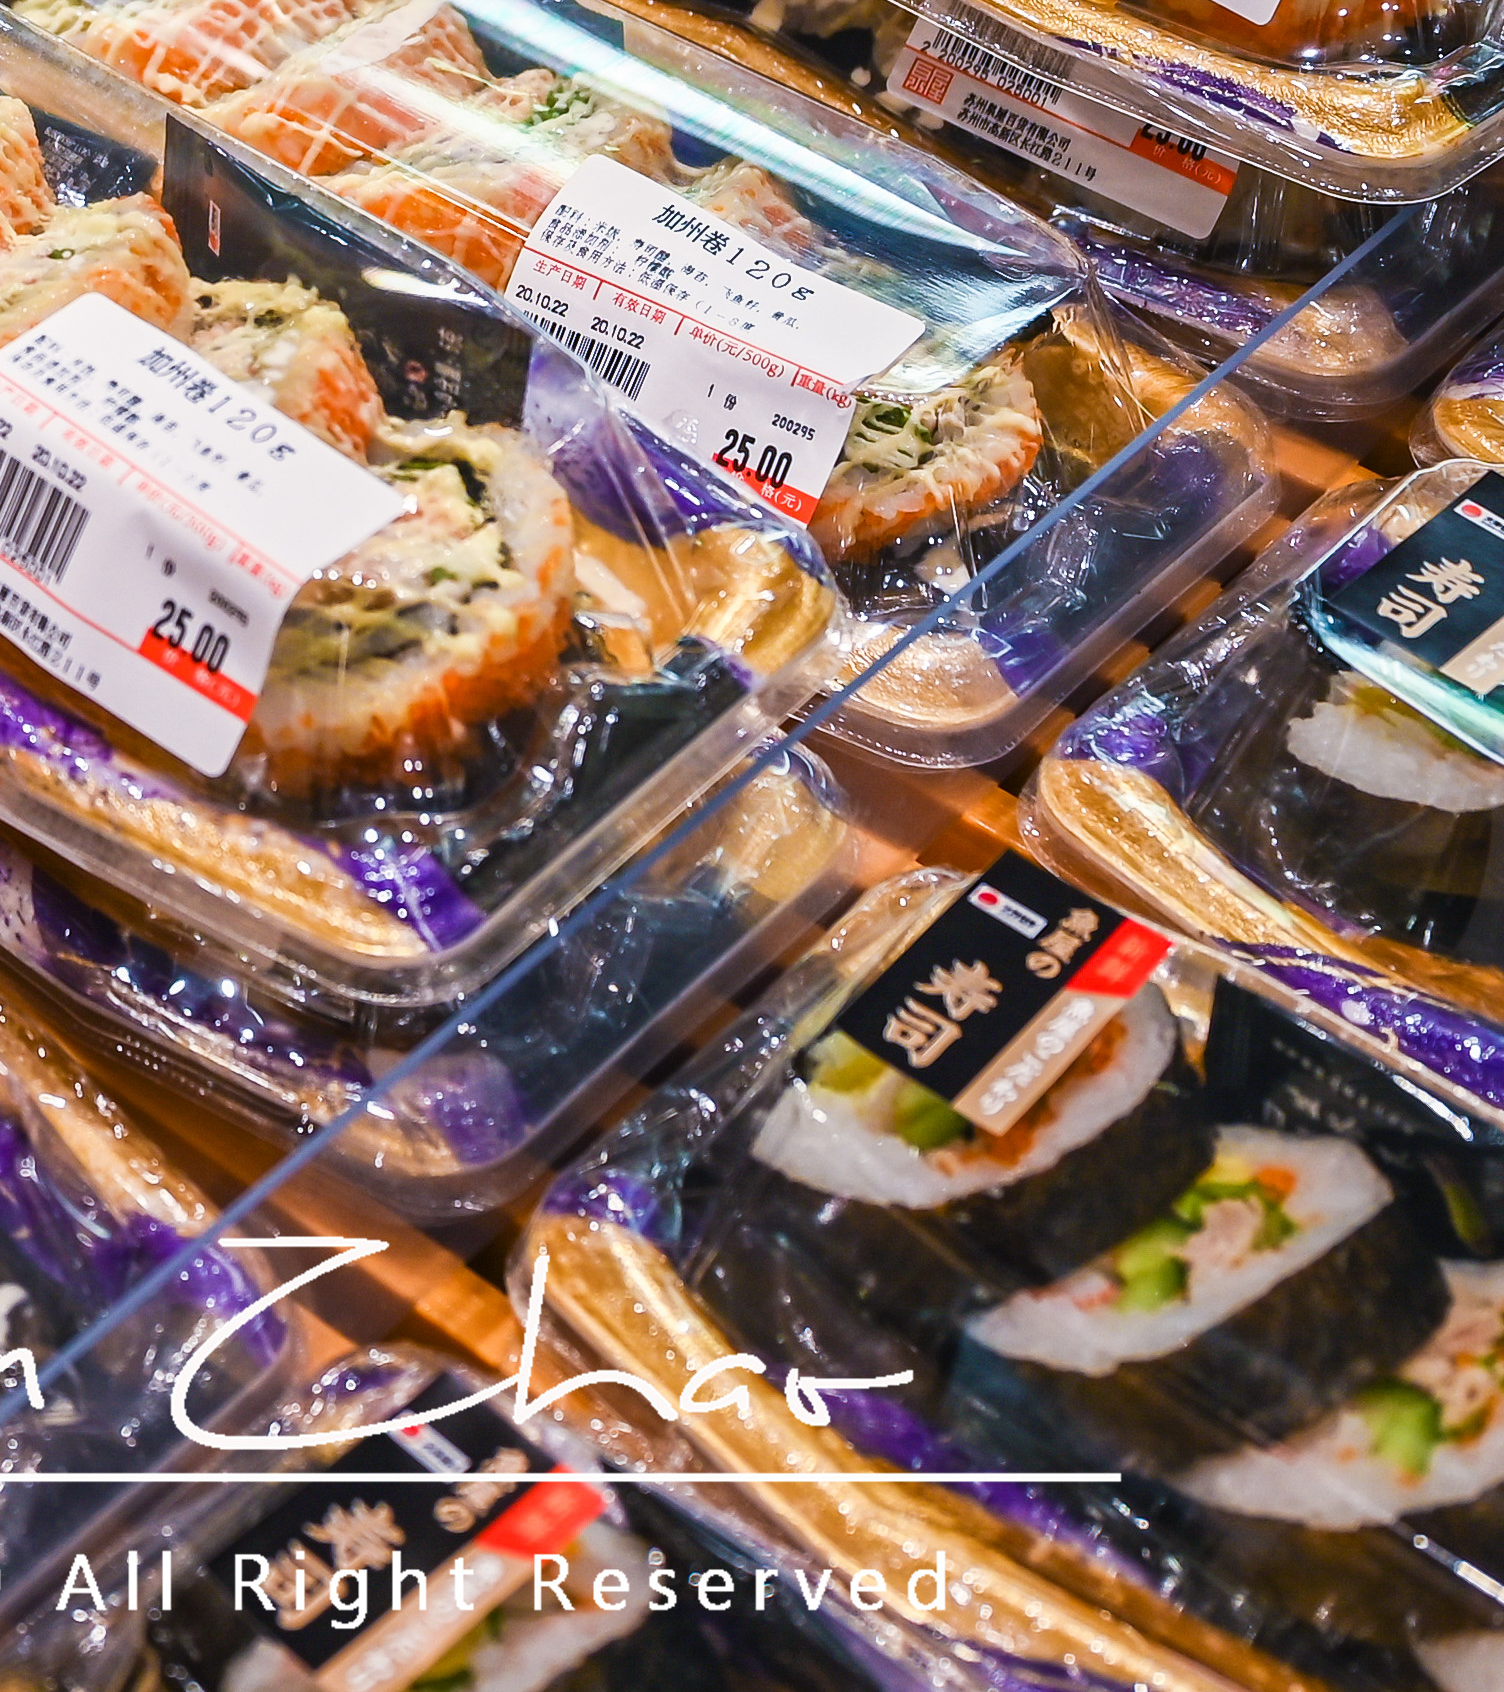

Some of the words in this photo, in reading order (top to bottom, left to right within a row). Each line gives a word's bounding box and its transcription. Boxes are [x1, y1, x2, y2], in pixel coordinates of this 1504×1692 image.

[920, 41, 931, 55] 2
[937, 50, 990, 83] 200295
[995, 76, 1049, 108] 025001
[956, 108, 1098, 182] 苏州市高新区长江路211号
[1181, 156, 1223, 185] 格(元)
[651, 204, 815, 301] 加州卷120g
[515, 284, 569, 317] 20.10.22
[590, 316, 645, 350] 20.10.22
[533, 259, 586, 291] 生产日期
[613, 291, 665, 325] 有效日期
[689, 326, 785, 378] 单价(元/500g)
[799, 372, 853, 408] 重量(kg)
[707, 384, 713, 398] 1
[722, 393, 737, 410] 份
[772, 414, 816, 440] 200295
[716, 429, 793, 488] 25.00
[761, 482, 803, 511] 格(元)
[1376, 556, 1485, 639] 寿司
[153, 599, 231, 675] 25.00
[882, 957, 1003, 1069] 寿司
